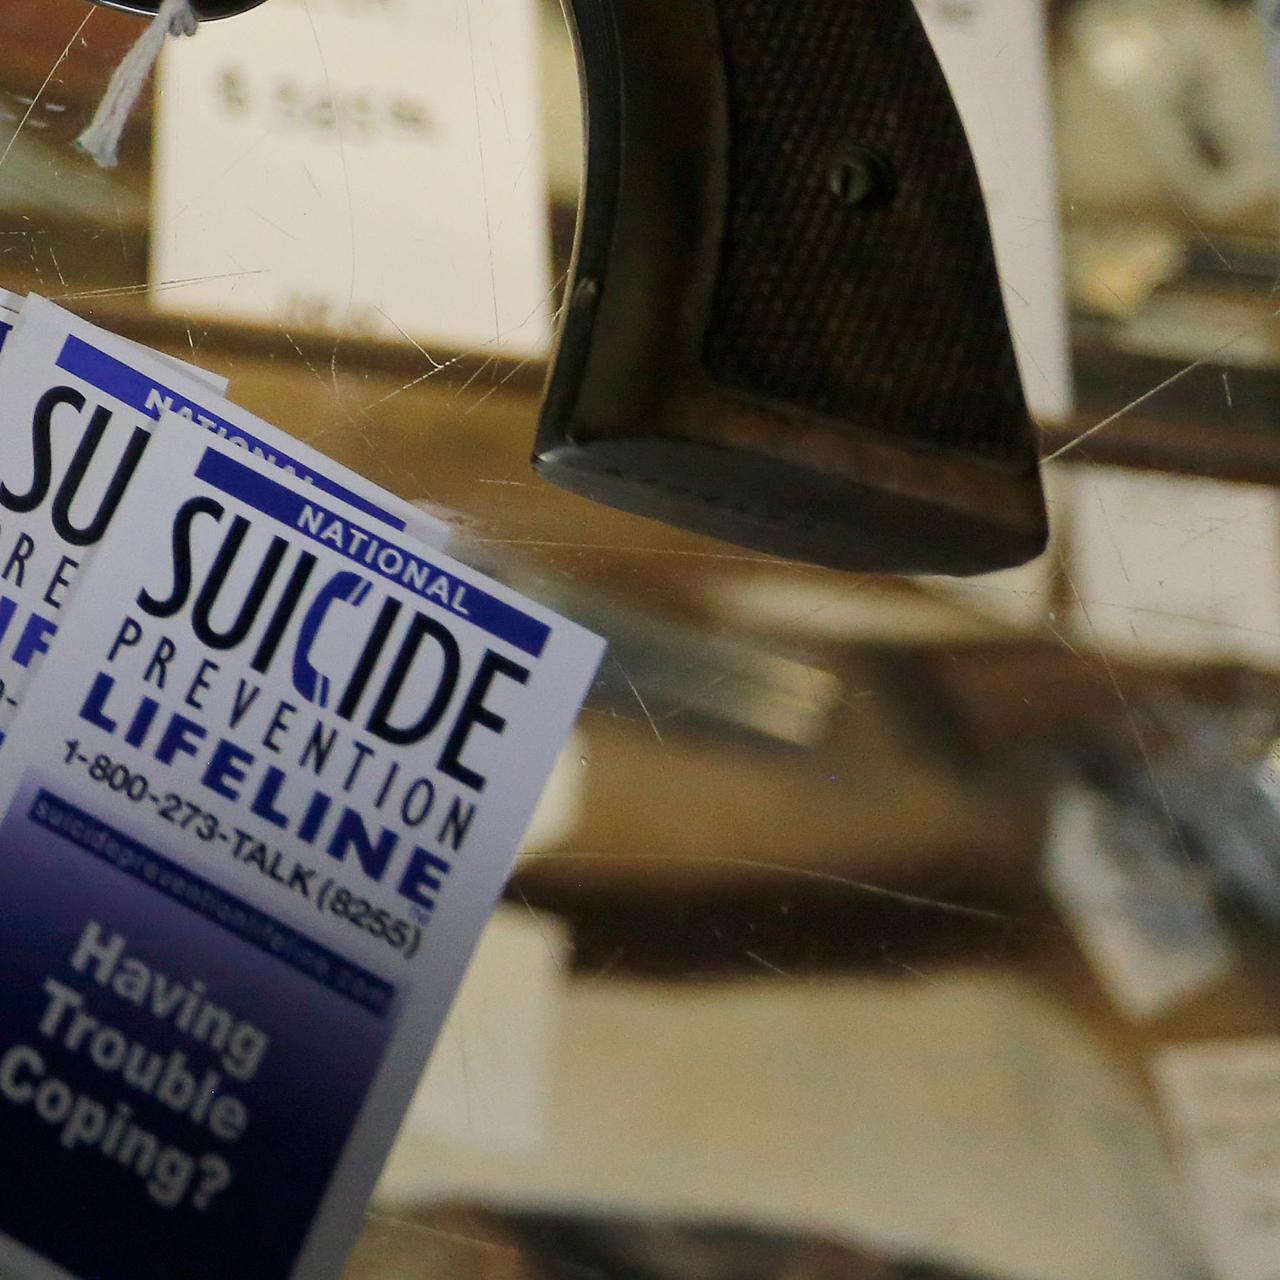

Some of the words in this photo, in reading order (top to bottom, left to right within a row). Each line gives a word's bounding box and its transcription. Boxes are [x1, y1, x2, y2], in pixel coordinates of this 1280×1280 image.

[135, 495, 532, 792] SUICIDE
[296, 503, 474, 618] NATIONAL
[78, 671, 452, 910] LIFELINE
[105, 616, 478, 852] PREVENTION
[62, 738, 318, 899] 1-800-273-TALK
[316, 877, 422, 960] (8255)
[35, 977, 249, 1142] Trouble
[69, 919, 271, 1082] Having
